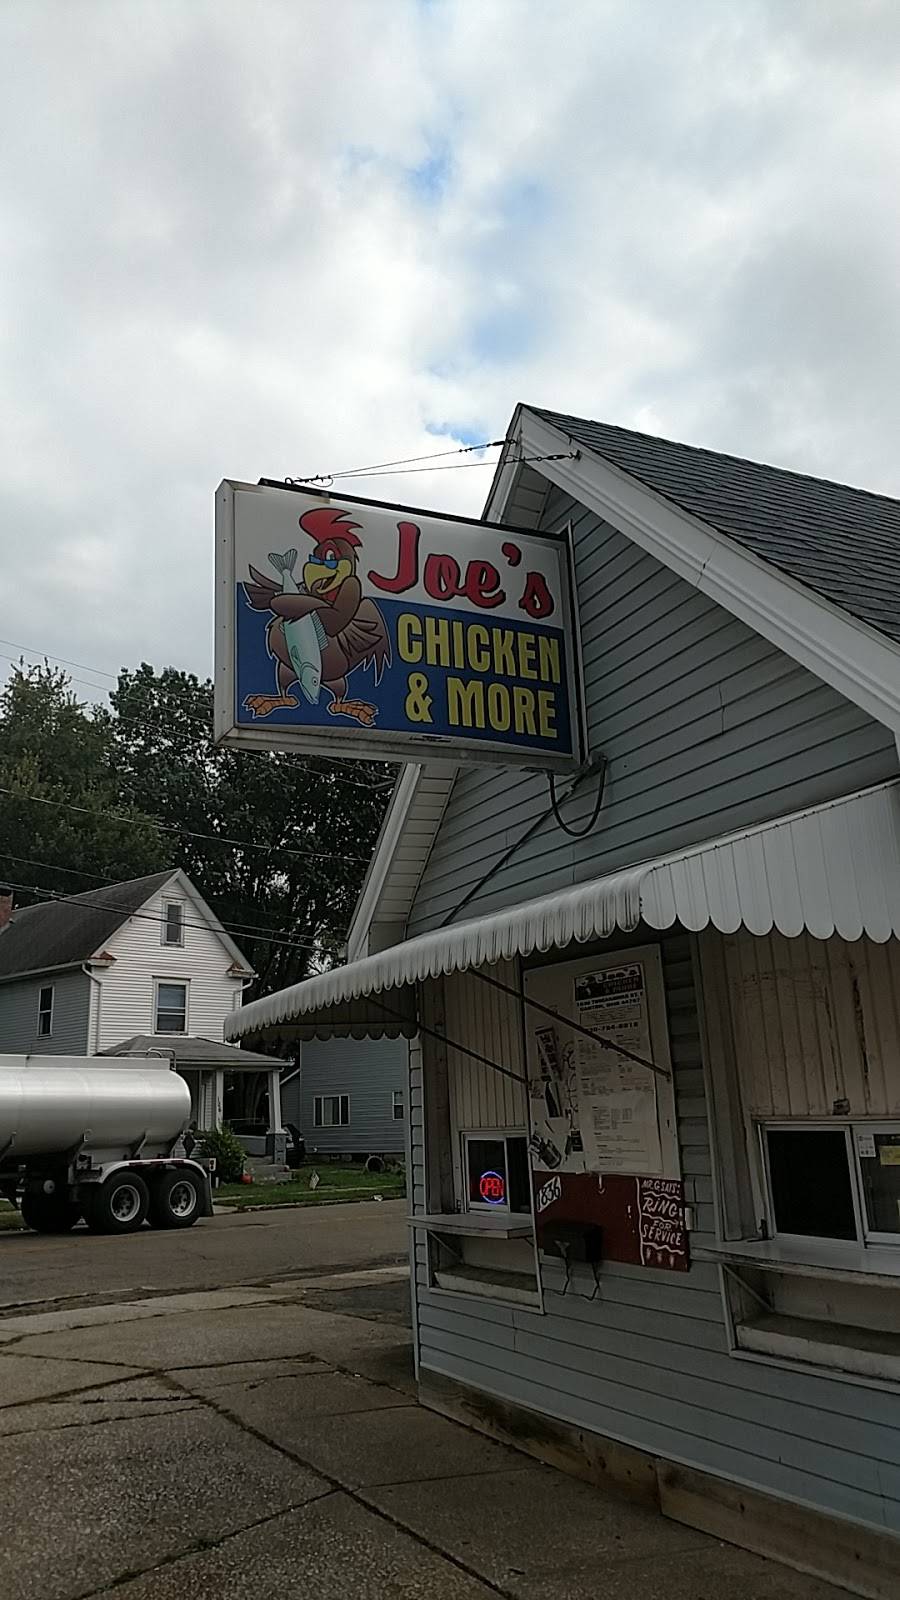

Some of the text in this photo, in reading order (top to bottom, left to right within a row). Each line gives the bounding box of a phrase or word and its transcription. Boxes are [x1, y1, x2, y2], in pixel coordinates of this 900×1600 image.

[367, 521, 554, 619] Joe's
[397, 612, 561, 684] CHICKEN
[405, 672, 558, 738] & MORE
[643, 1197, 678, 1218] RING
[653, 1220, 672, 1232] FOR
[642, 1224, 682, 1246] SERVICE
